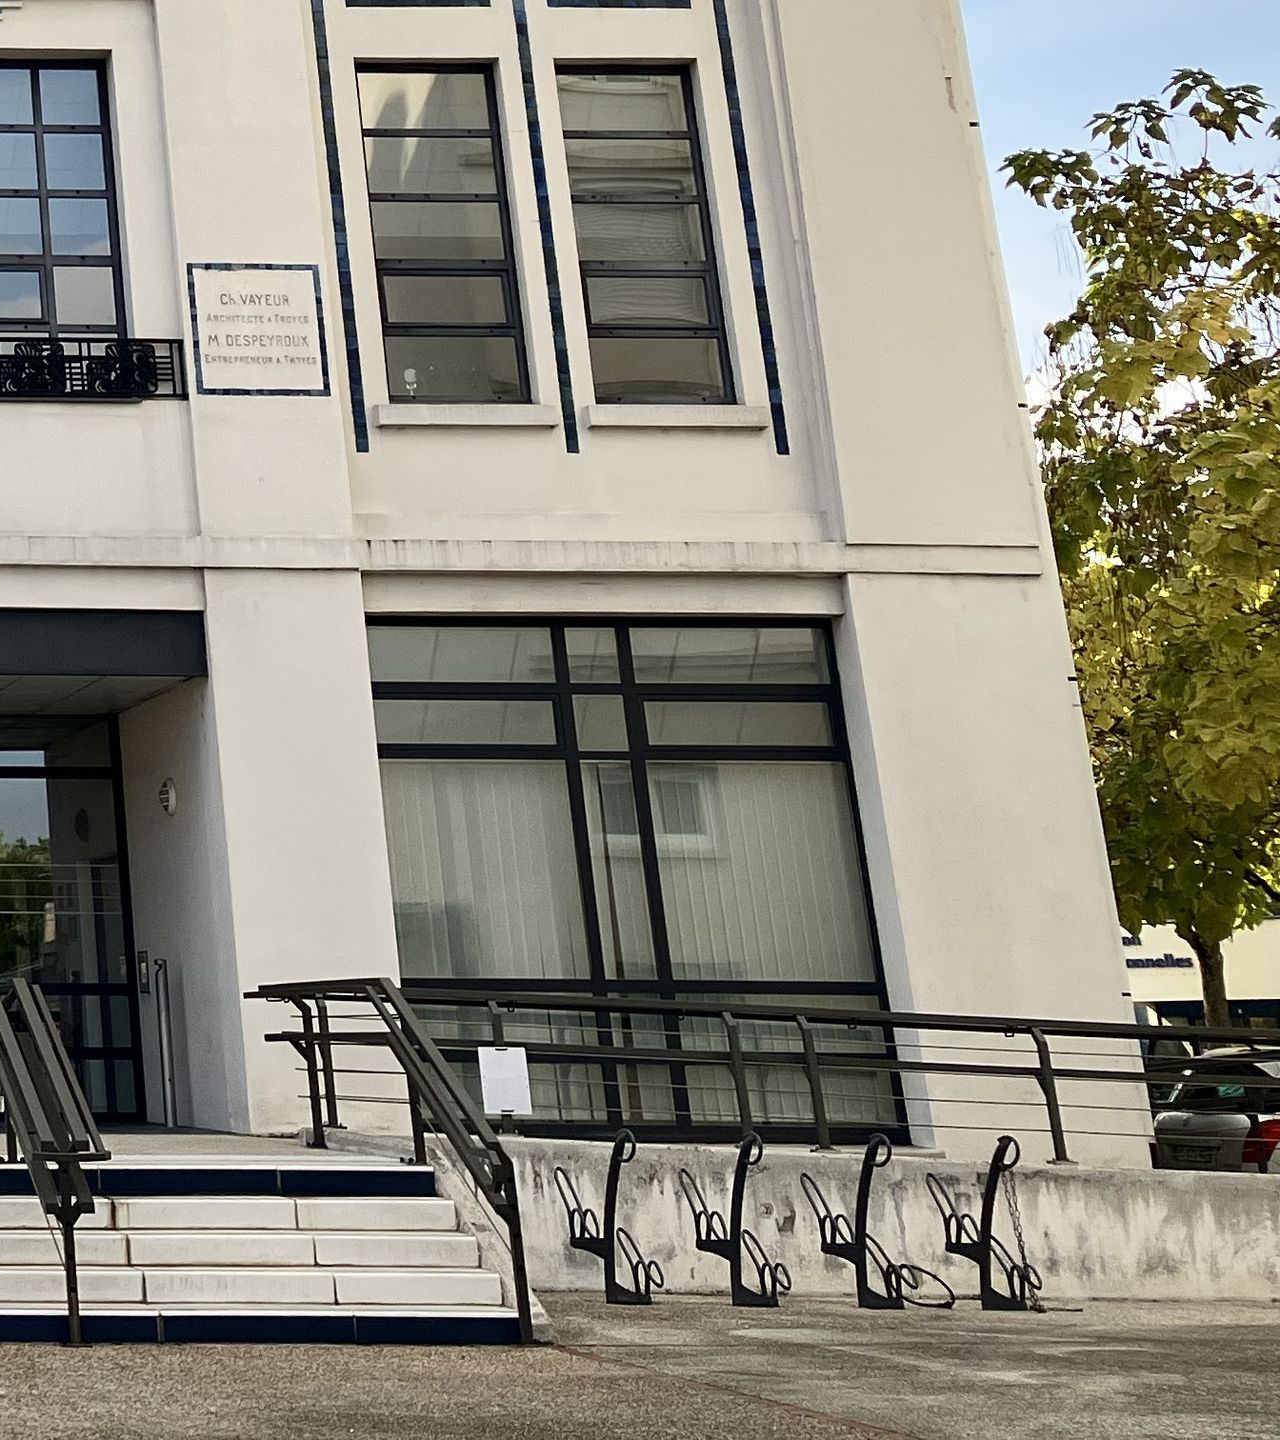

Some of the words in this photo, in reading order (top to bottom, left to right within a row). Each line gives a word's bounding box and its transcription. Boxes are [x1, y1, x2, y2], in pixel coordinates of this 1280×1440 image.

[240, 294, 289, 306] VAYEUR
[206, 313, 265, 325] ARCHITECTE
[274, 314, 310, 325] TROYES
[225, 334, 310, 347] DESPEYROUX
[204, 354, 273, 365] ENTREPRENEUR
